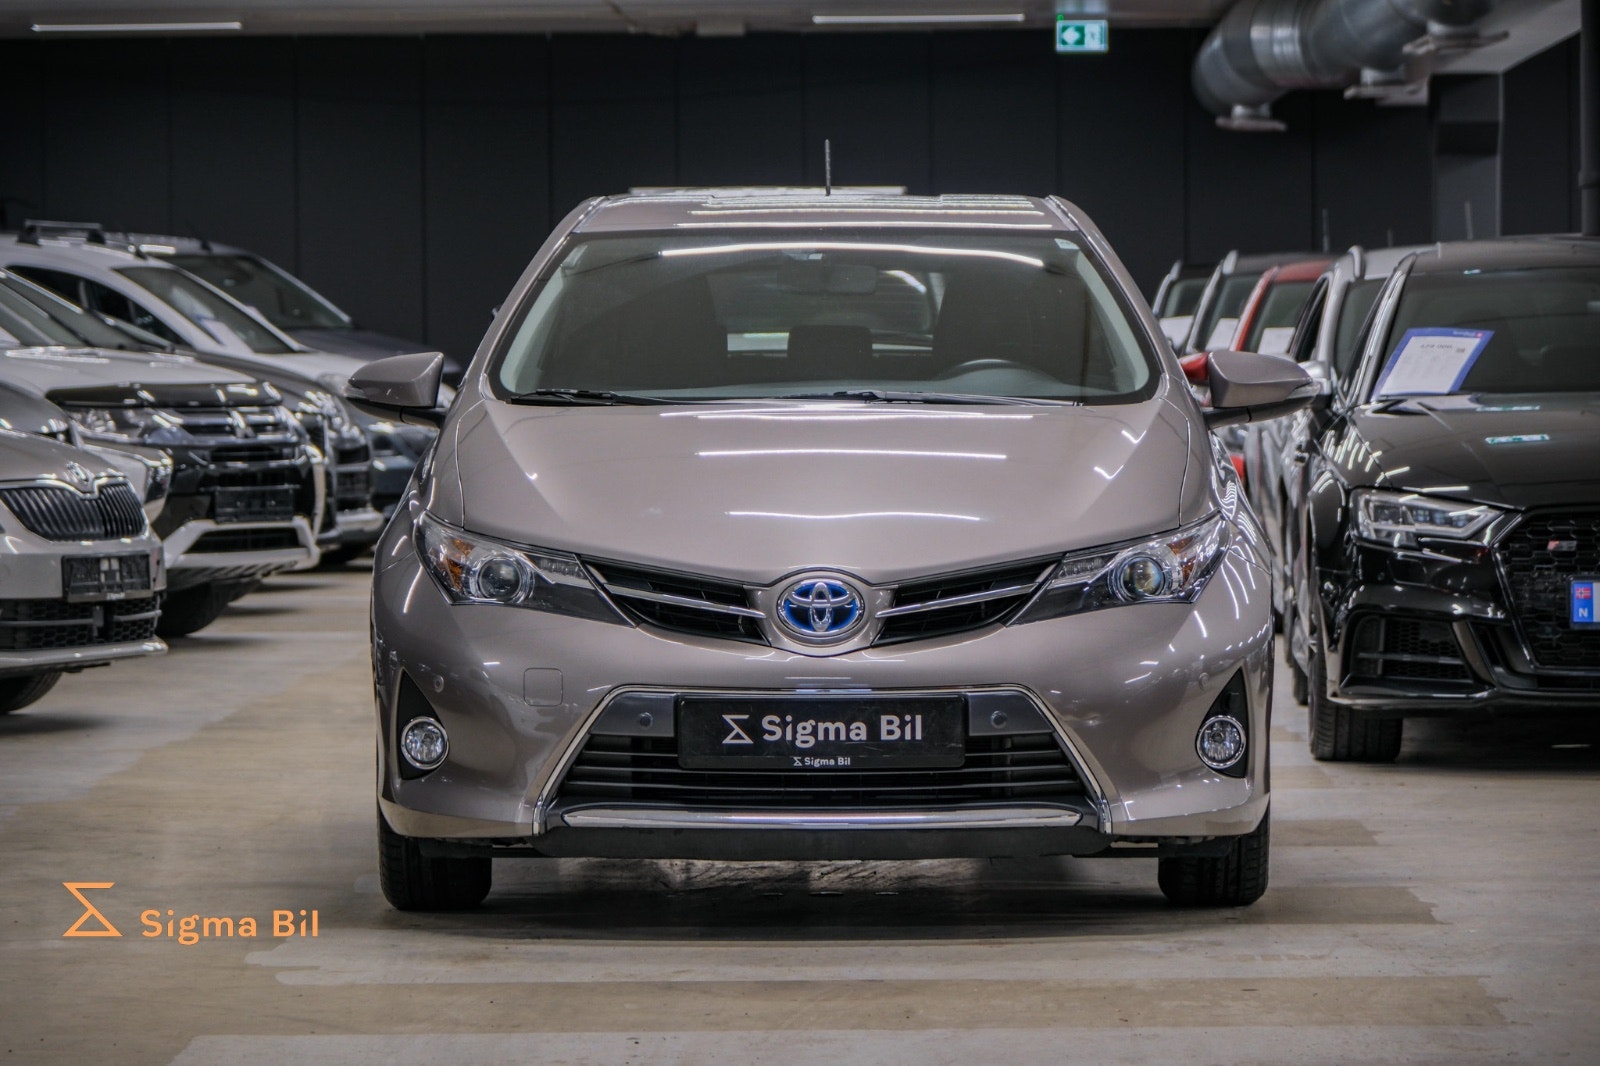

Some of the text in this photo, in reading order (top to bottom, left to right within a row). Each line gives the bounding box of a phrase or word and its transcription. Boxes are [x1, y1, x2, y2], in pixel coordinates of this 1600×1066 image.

[1578, 607, 1588, 618] N
[761, 714, 922, 748] Sigma Bil
[804, 756, 851, 767] Sigma Bil
